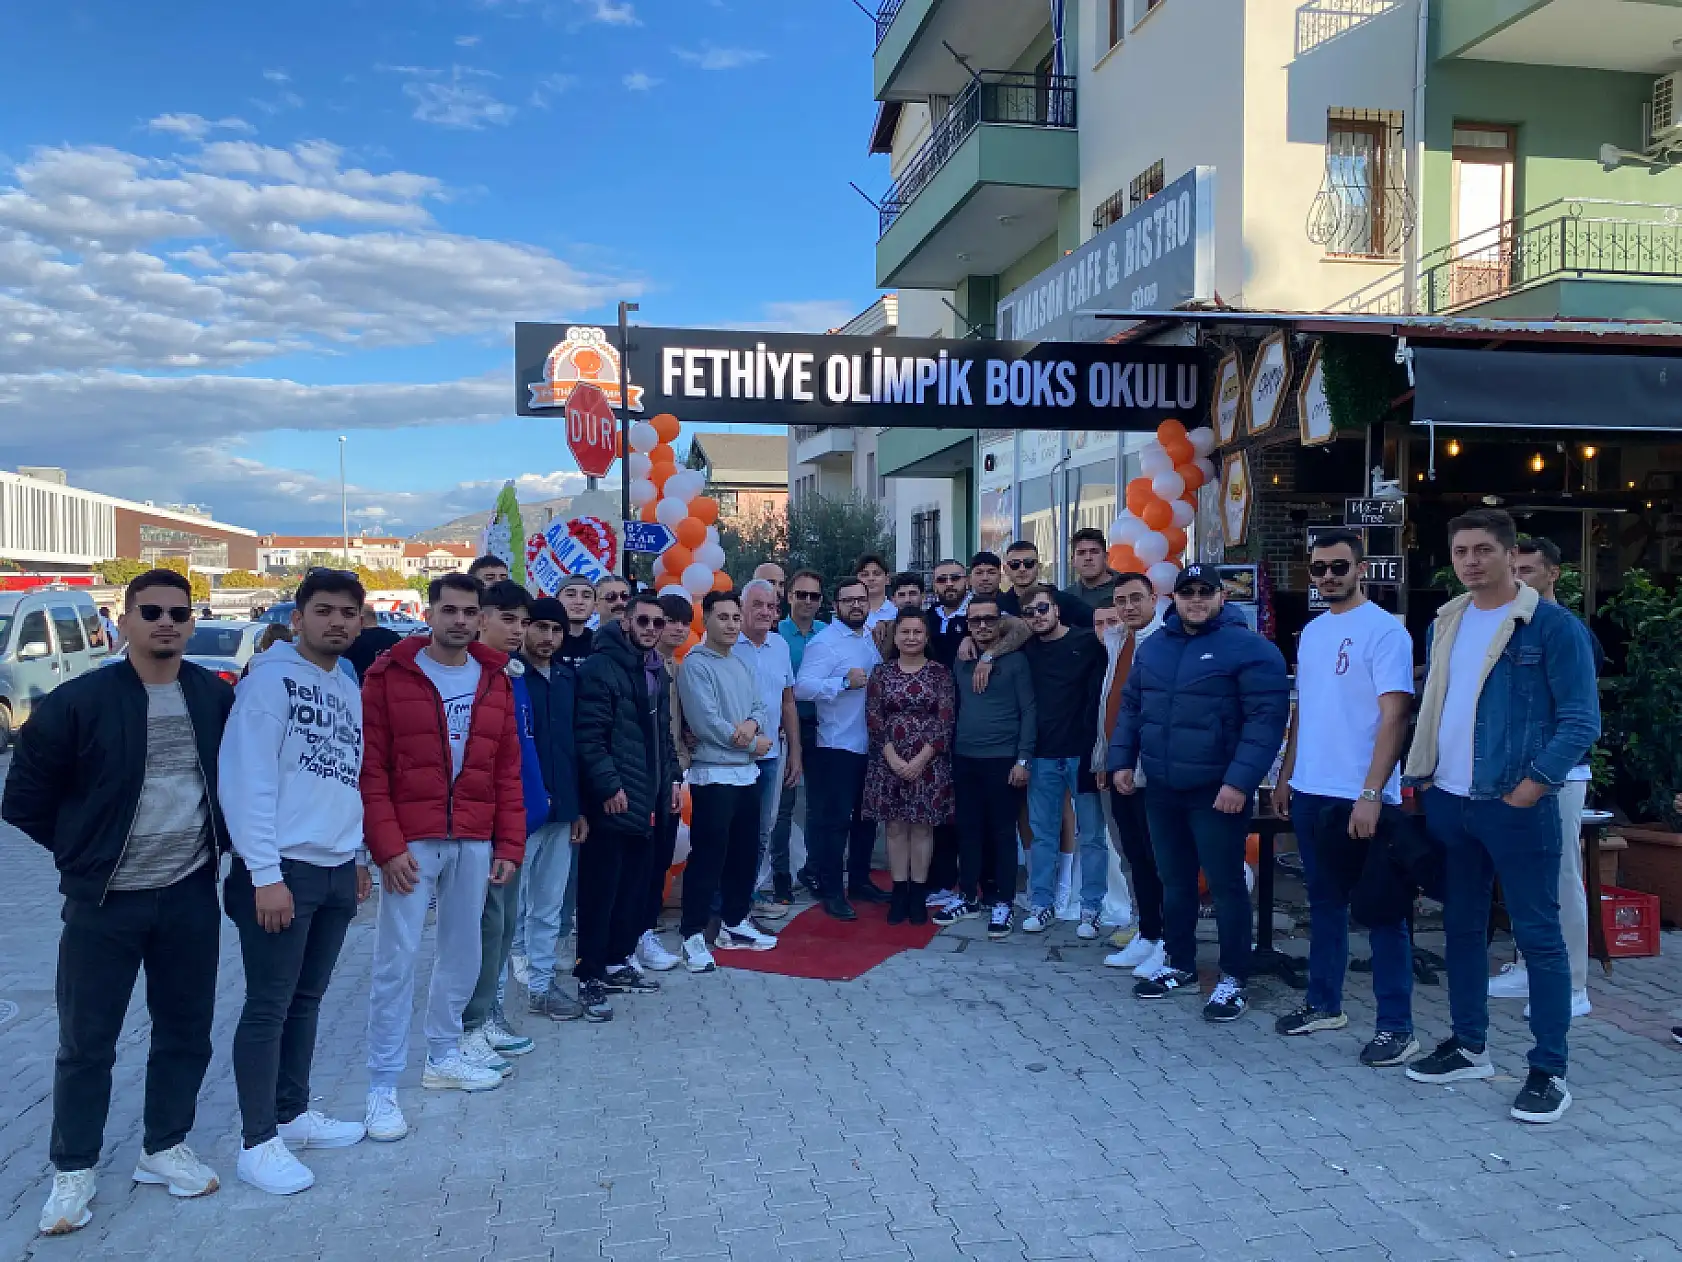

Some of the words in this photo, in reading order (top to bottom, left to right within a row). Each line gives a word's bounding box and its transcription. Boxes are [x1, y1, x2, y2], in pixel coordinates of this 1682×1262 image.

[1068, 249, 1101, 311] CAFE
[1105, 240, 1120, 290] &
[1124, 190, 1191, 279] BISTRO
[662, 341, 814, 401] FETHİYE
[826, 347, 974, 406] OLİMPİK
[985, 359, 1076, 408] BOKS
[1088, 361, 1198, 409] OKULU
[569, 408, 612, 450] DUR
